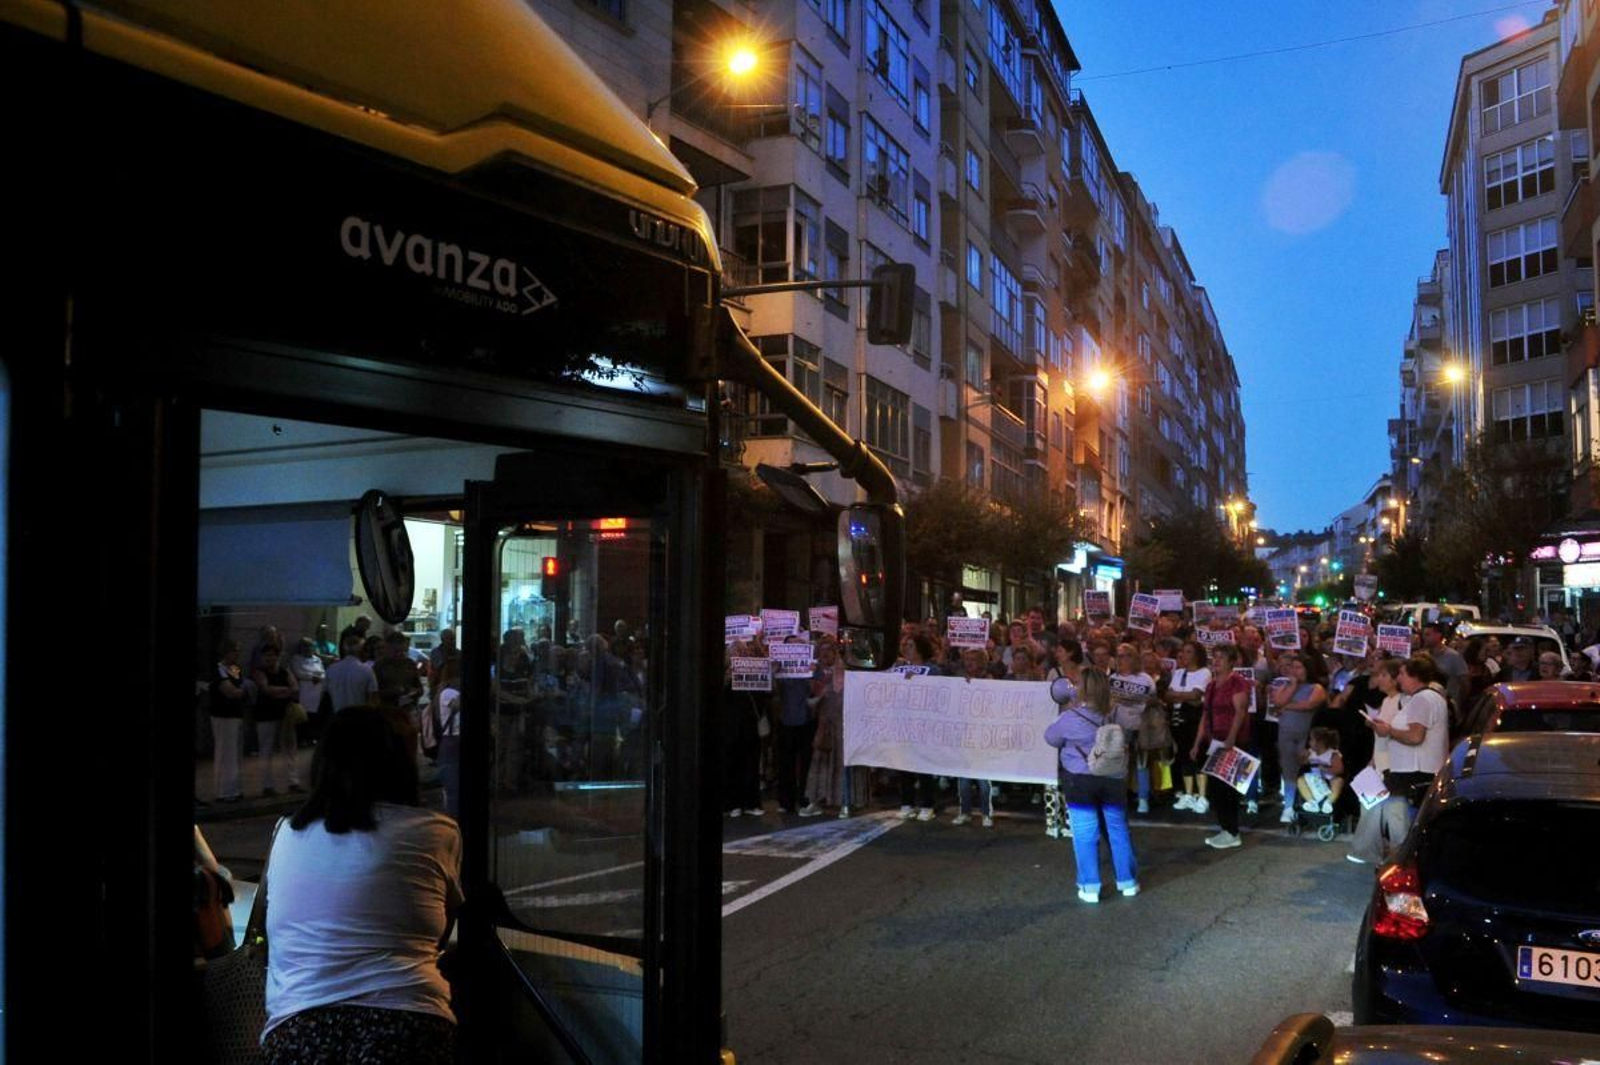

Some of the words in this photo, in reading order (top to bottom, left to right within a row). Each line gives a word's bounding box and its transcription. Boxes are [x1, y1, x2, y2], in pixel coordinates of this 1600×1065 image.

[340, 215, 519, 298] avanza
[1341, 612, 1348, 620] O
[863, 682, 951, 714] CUDEIRO
[958, 686, 997, 719] POR
[1000, 690, 1036, 720] UN
[1113, 680, 1121, 688] O
[1123, 681, 1146, 694] VISO
[979, 722, 1036, 752] DIGNO
